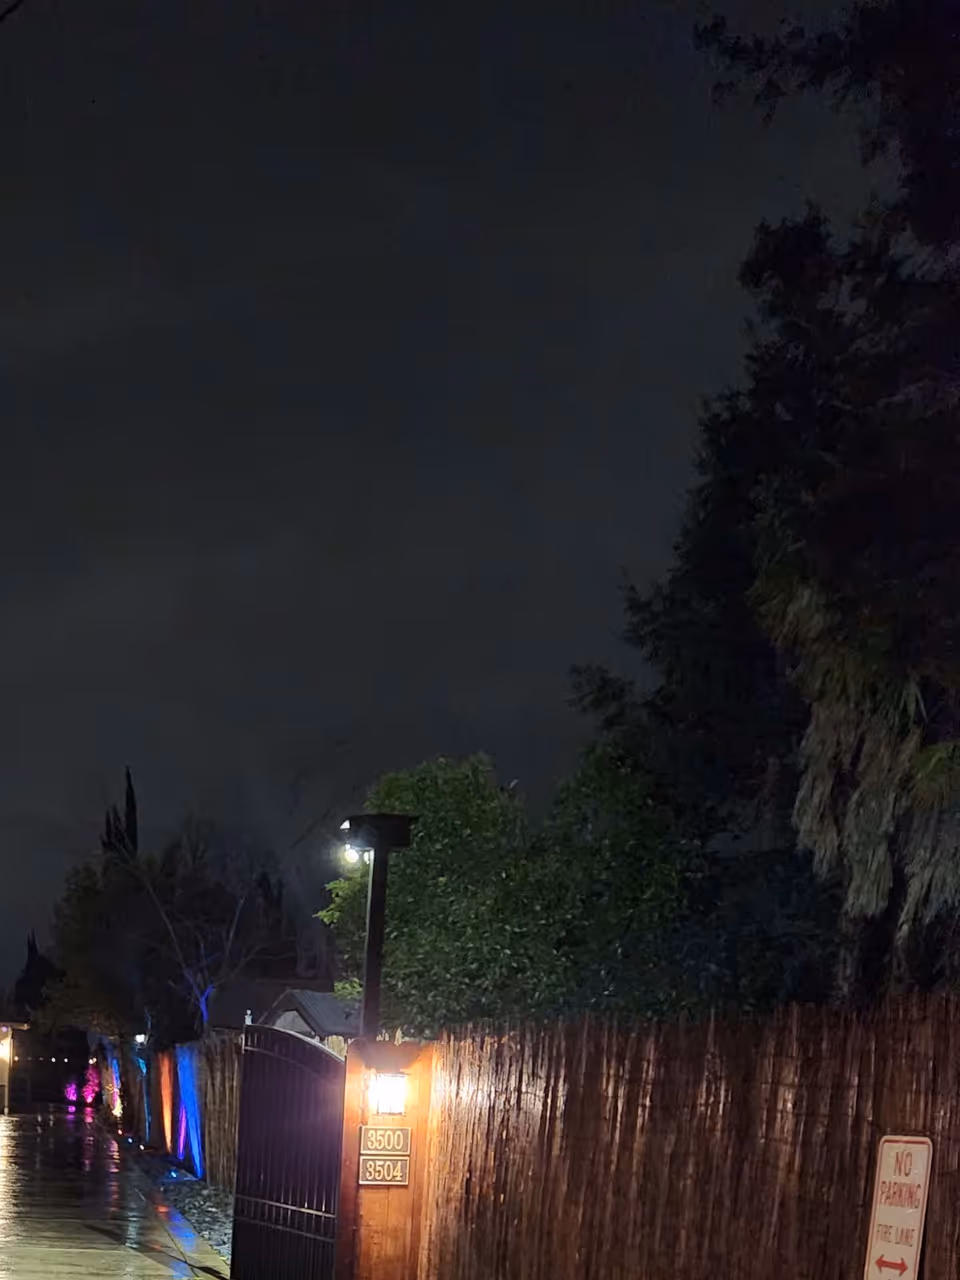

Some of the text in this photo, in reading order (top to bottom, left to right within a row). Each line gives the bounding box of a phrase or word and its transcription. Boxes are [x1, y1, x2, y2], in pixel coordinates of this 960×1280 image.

[367, 1130, 403, 1150] 3500
[366, 1161, 402, 1181] 3504
[893, 1150, 913, 1177] NO
[880, 1180, 921, 1208] PARKING
[876, 1223, 915, 1247] FIRE LANE
